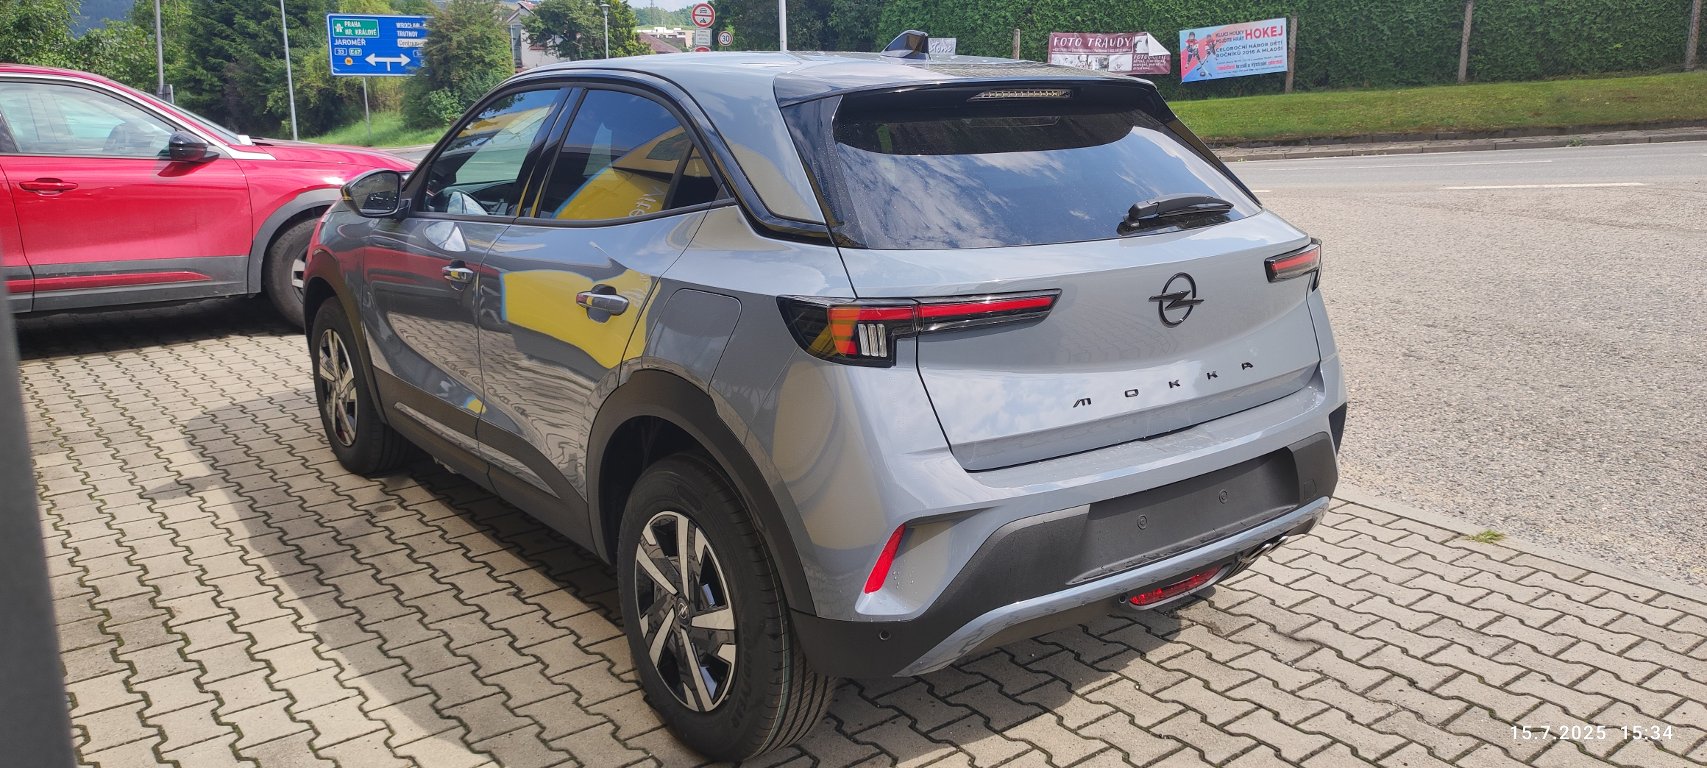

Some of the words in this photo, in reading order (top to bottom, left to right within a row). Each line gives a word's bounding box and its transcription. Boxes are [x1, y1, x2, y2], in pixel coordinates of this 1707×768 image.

[1245, 25, 1283, 41] HOKEJ
[1053, 37, 1082, 47] FOTO
[1087, 36, 1132, 48] TRAUDY
[1216, 44, 1248, 52] CELOROČNÍ
[1073, 361, 1254, 408] MOKKA
